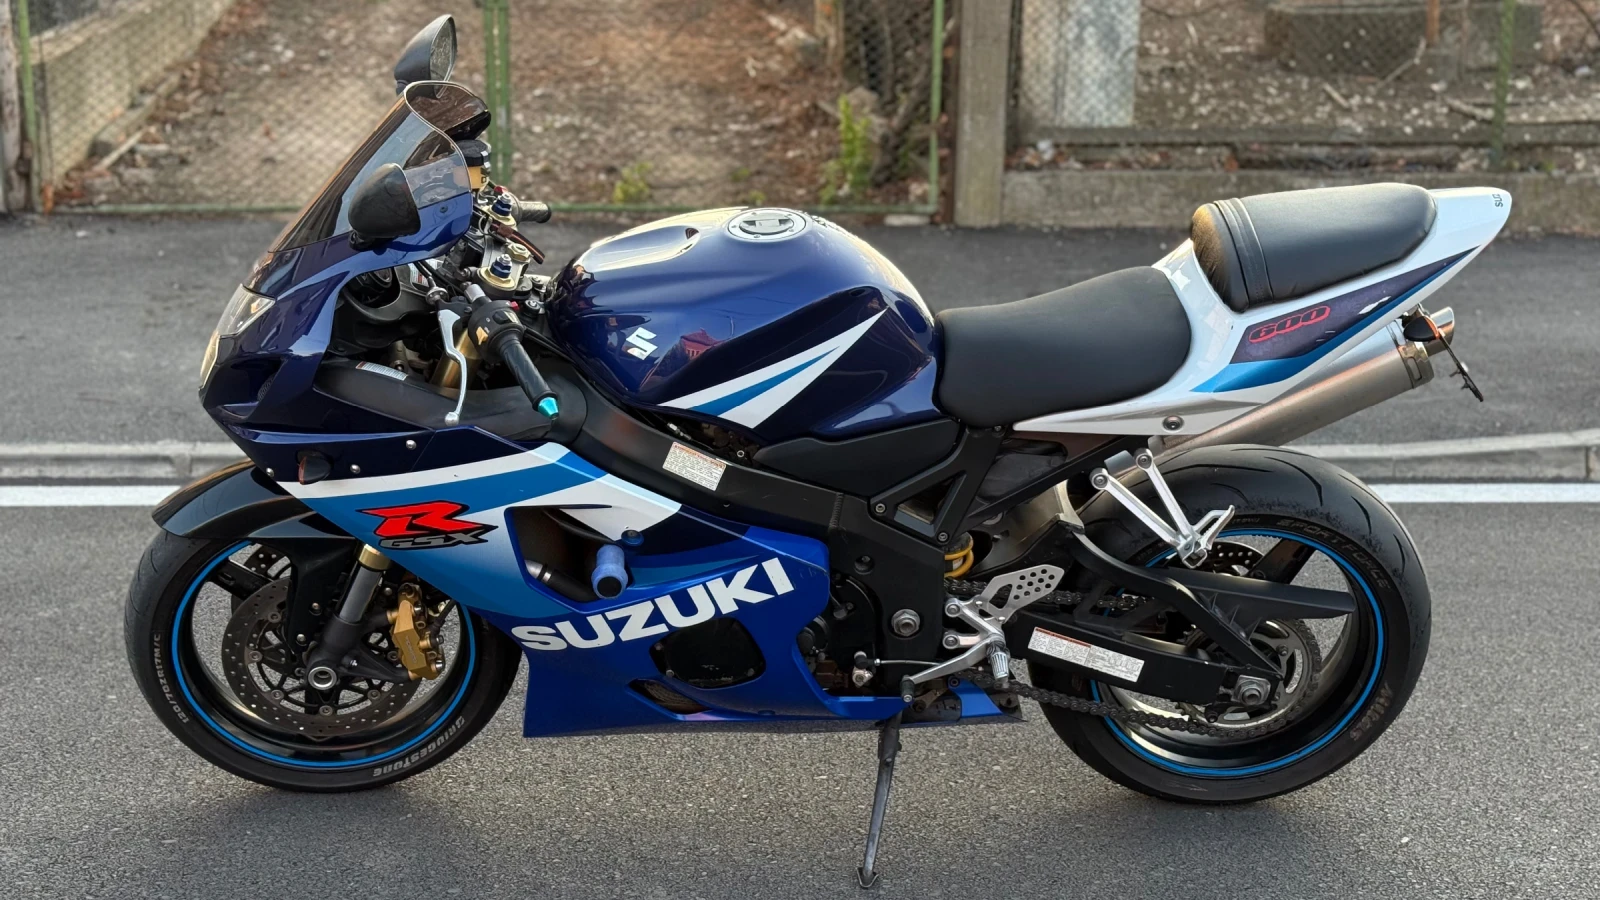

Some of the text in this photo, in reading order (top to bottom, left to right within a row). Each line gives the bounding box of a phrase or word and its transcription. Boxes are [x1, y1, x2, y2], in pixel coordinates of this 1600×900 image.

[1248, 305, 1331, 343] 600
[357, 500, 492, 537] R
[379, 529, 486, 549] GSX
[511, 557, 795, 651] SUZUKI
[373, 716, 465, 777] BRIDGESTONE
